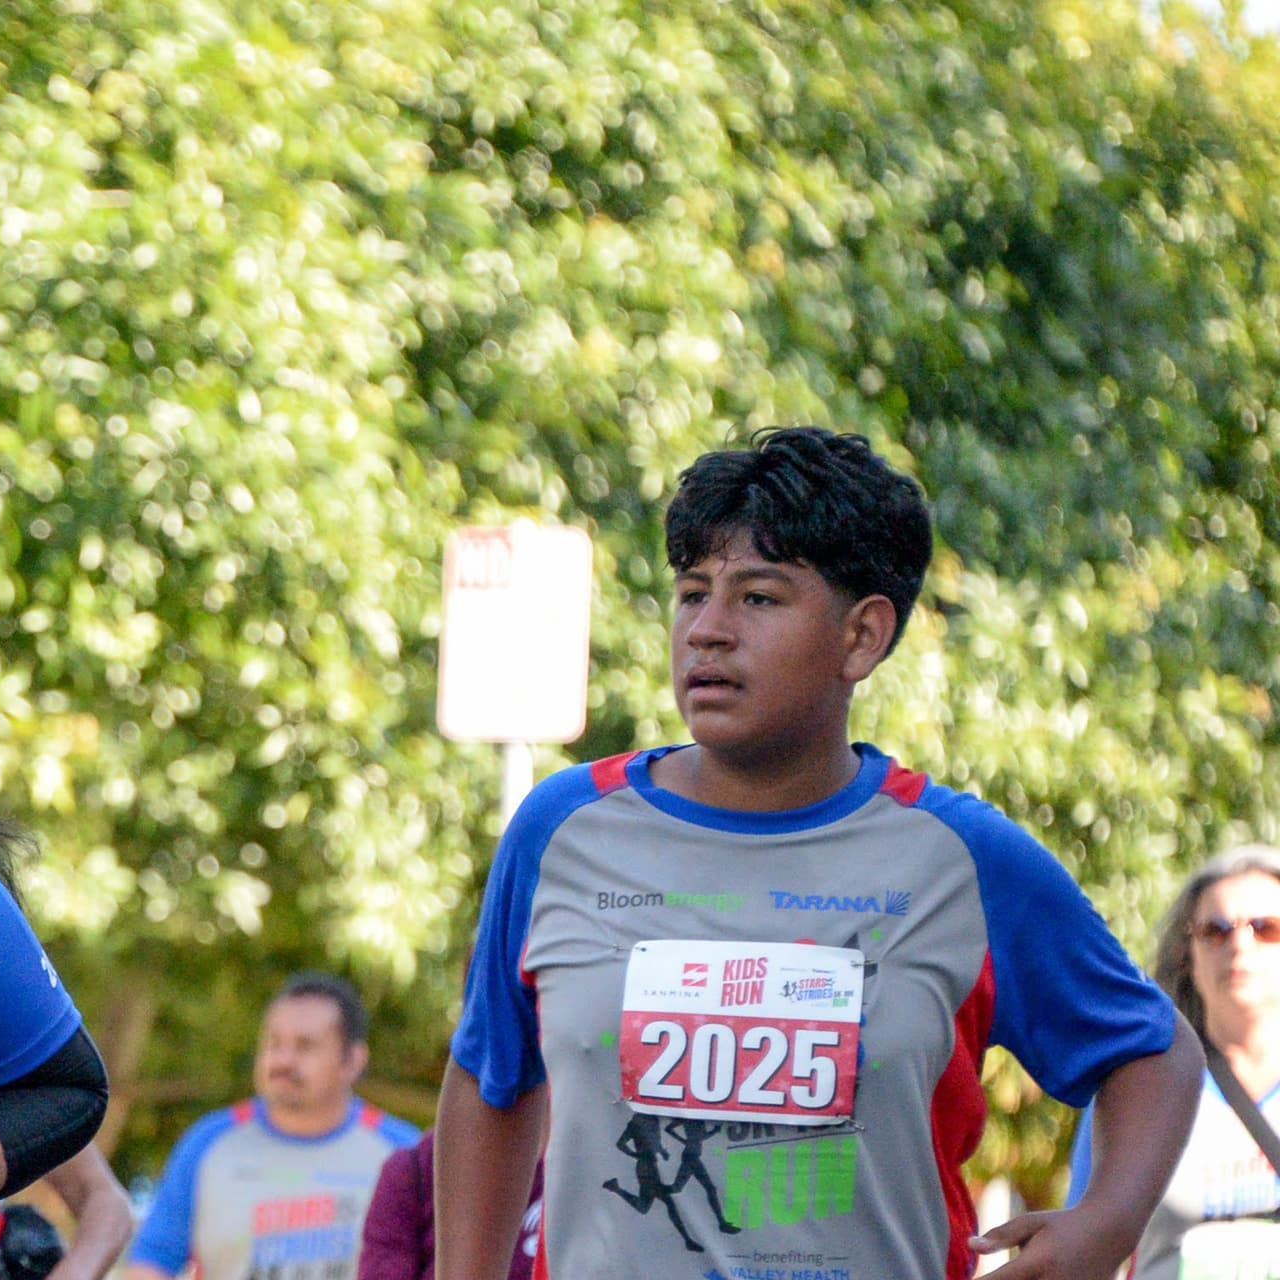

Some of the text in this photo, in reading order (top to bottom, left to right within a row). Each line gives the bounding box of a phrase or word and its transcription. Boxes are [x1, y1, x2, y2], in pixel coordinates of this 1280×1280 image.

[769, 891, 880, 912] TARANA
[723, 957, 769, 982] KIDS
[720, 981, 765, 1007] RUN
[639, 1020, 839, 1108] 2025
[725, 1136, 857, 1230] RUN
[754, 1250, 824, 1266] benefiting
